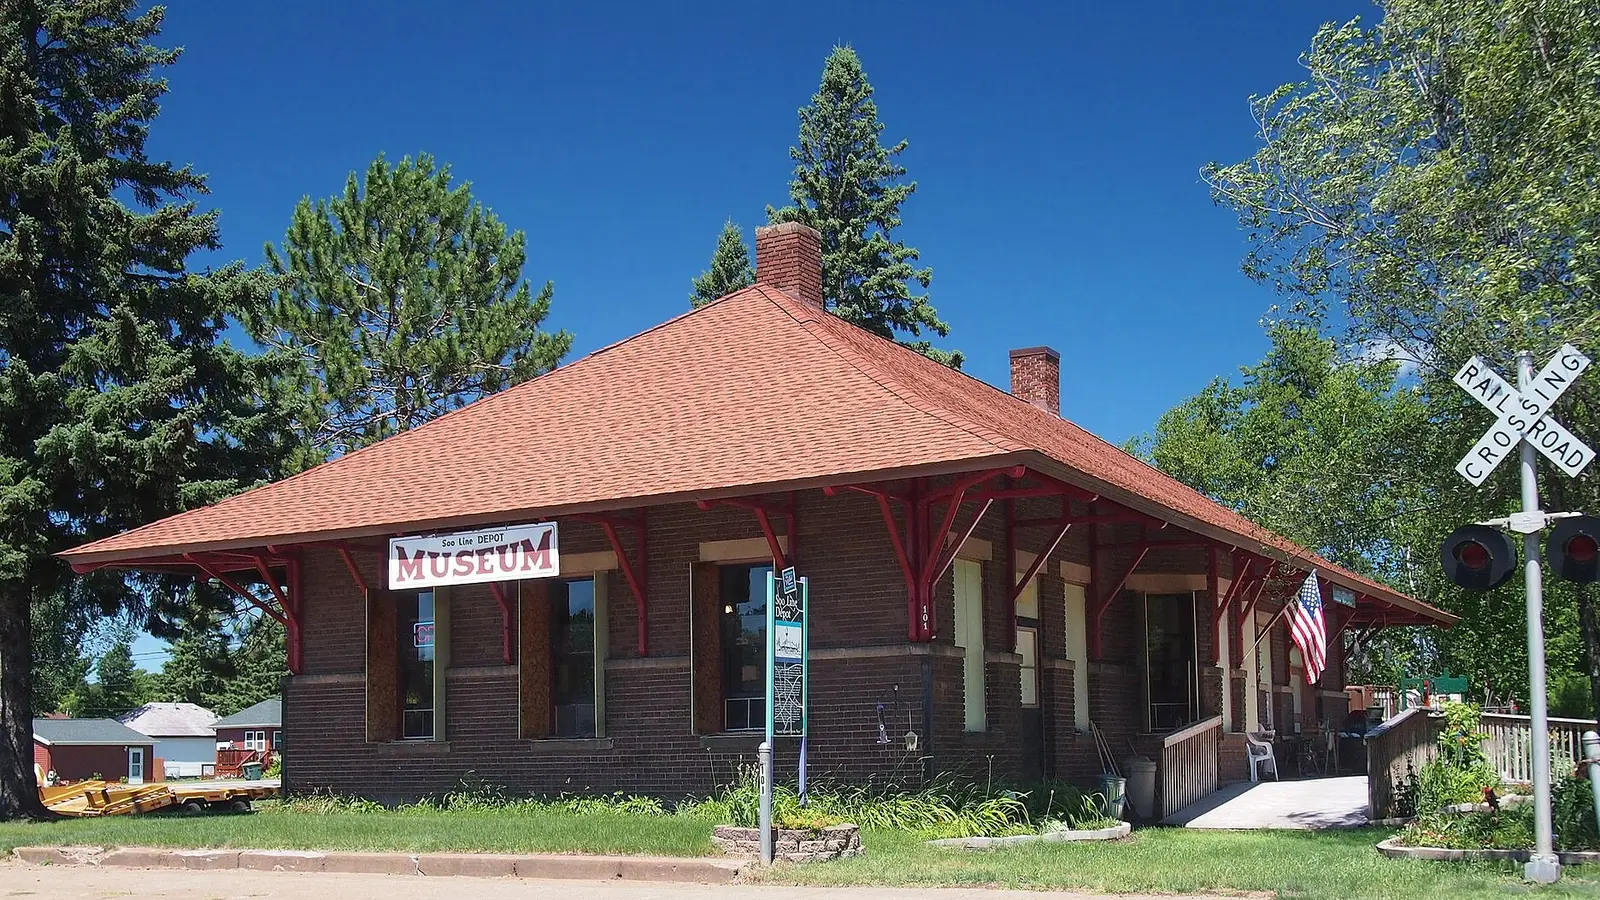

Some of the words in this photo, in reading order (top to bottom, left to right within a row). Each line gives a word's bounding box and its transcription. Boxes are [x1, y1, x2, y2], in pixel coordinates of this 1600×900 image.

[1465, 354, 1579, 479] CROSSING
[395, 529, 553, 582] MUSEUM
[441, 539, 456, 548] Soo
[458, 537, 474, 546] Line
[477, 533, 504, 544] DEPOT
[775, 606, 791, 620] Depot
